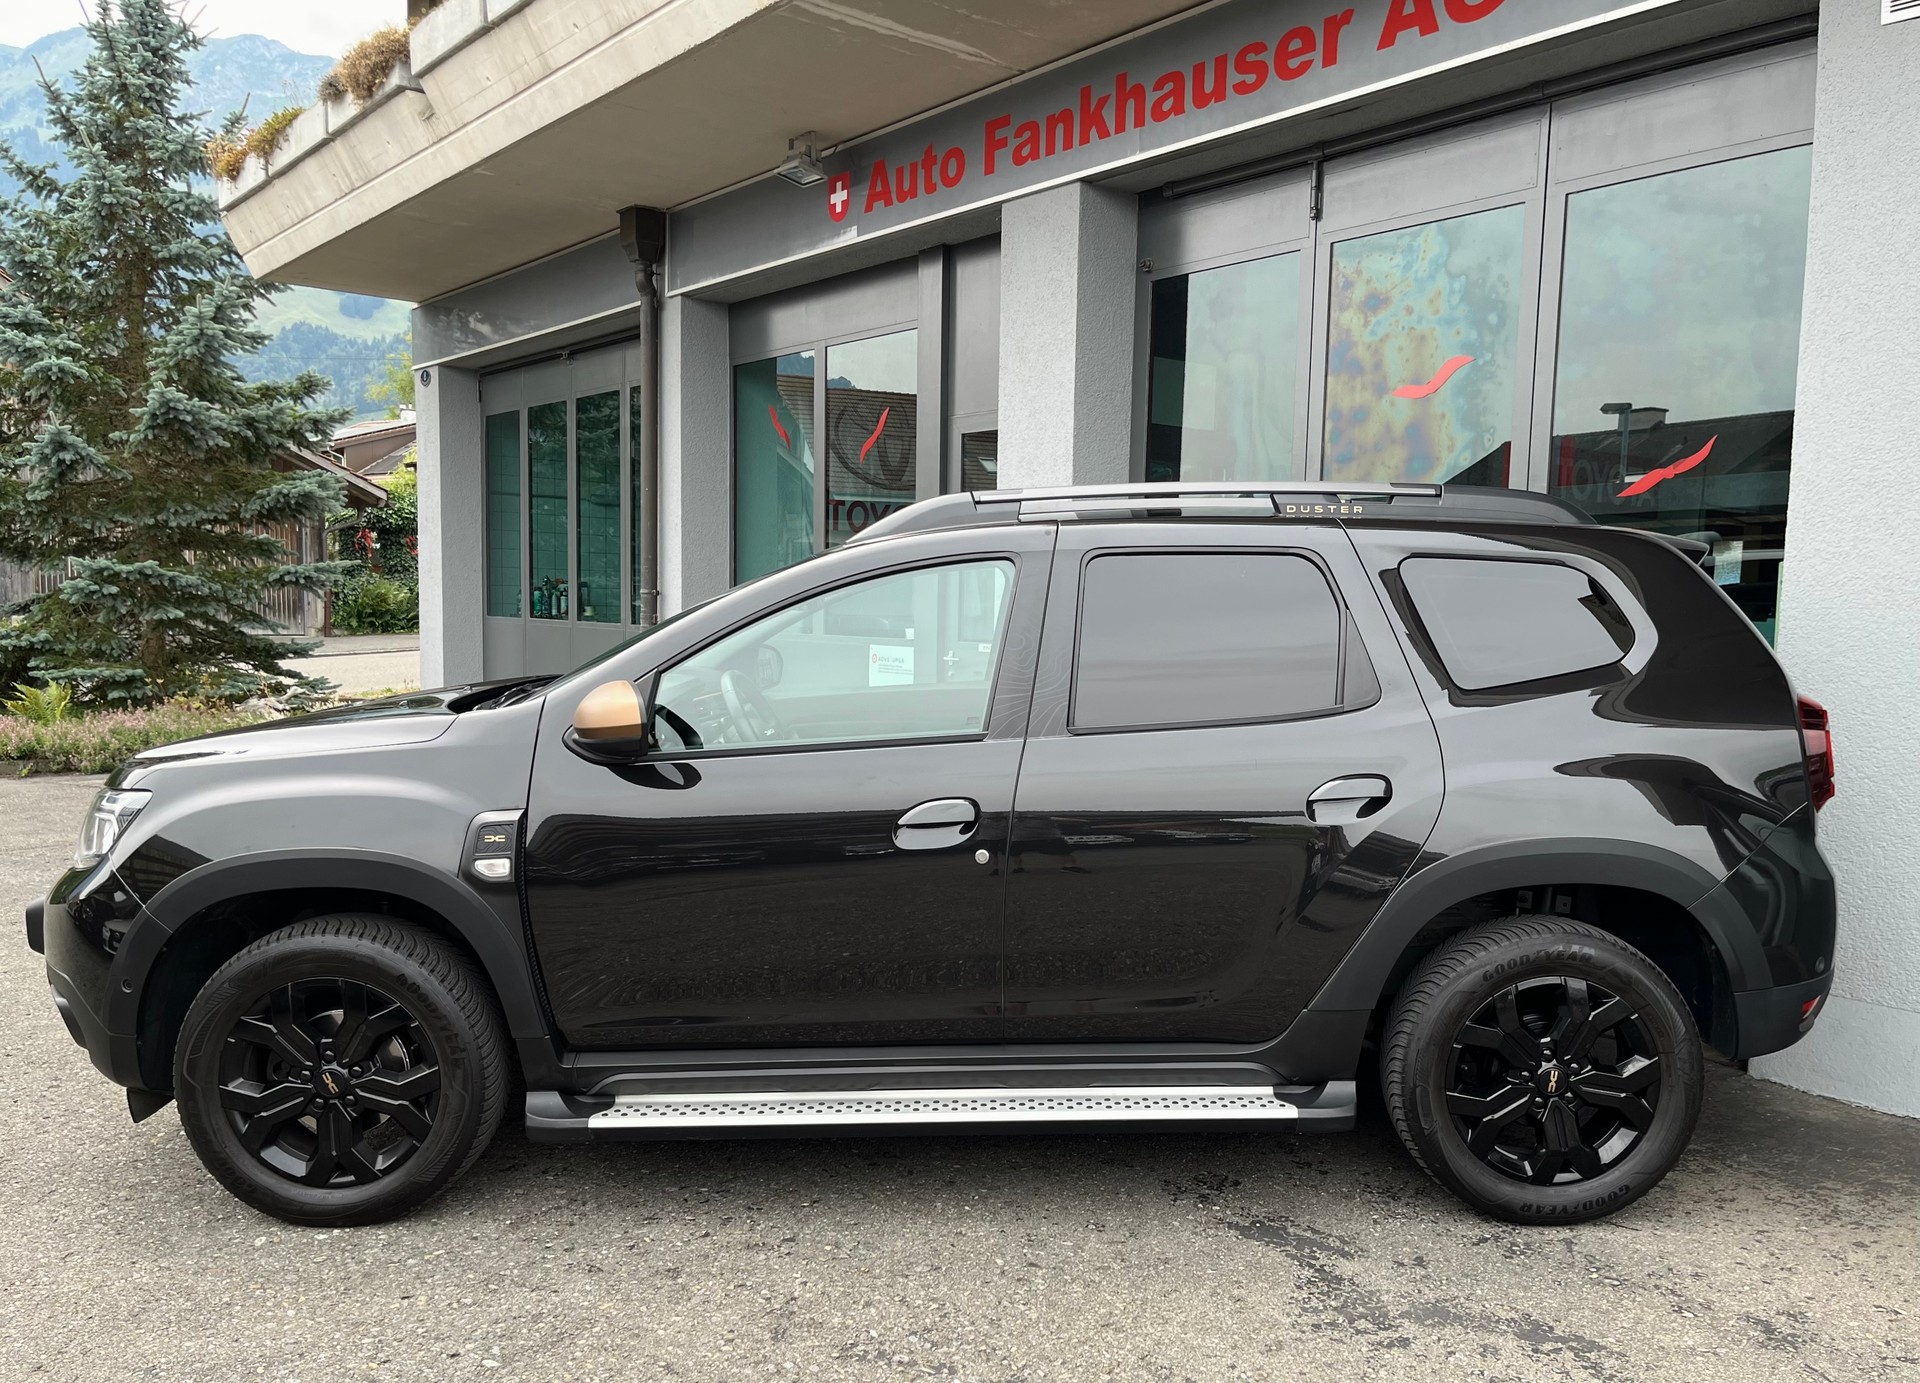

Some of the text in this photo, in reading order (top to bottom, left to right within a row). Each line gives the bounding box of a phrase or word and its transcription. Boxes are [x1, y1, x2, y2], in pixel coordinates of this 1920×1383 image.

[865, 147, 966, 214] Auto
[984, 9, 1355, 176] Fankhauser
[829, 499, 911, 534] TOY
[1286, 505, 1363, 514] DUSTER
[1482, 949, 1595, 982] GOODYEAR
[1519, 1184, 1631, 1215] GOODYEAR
